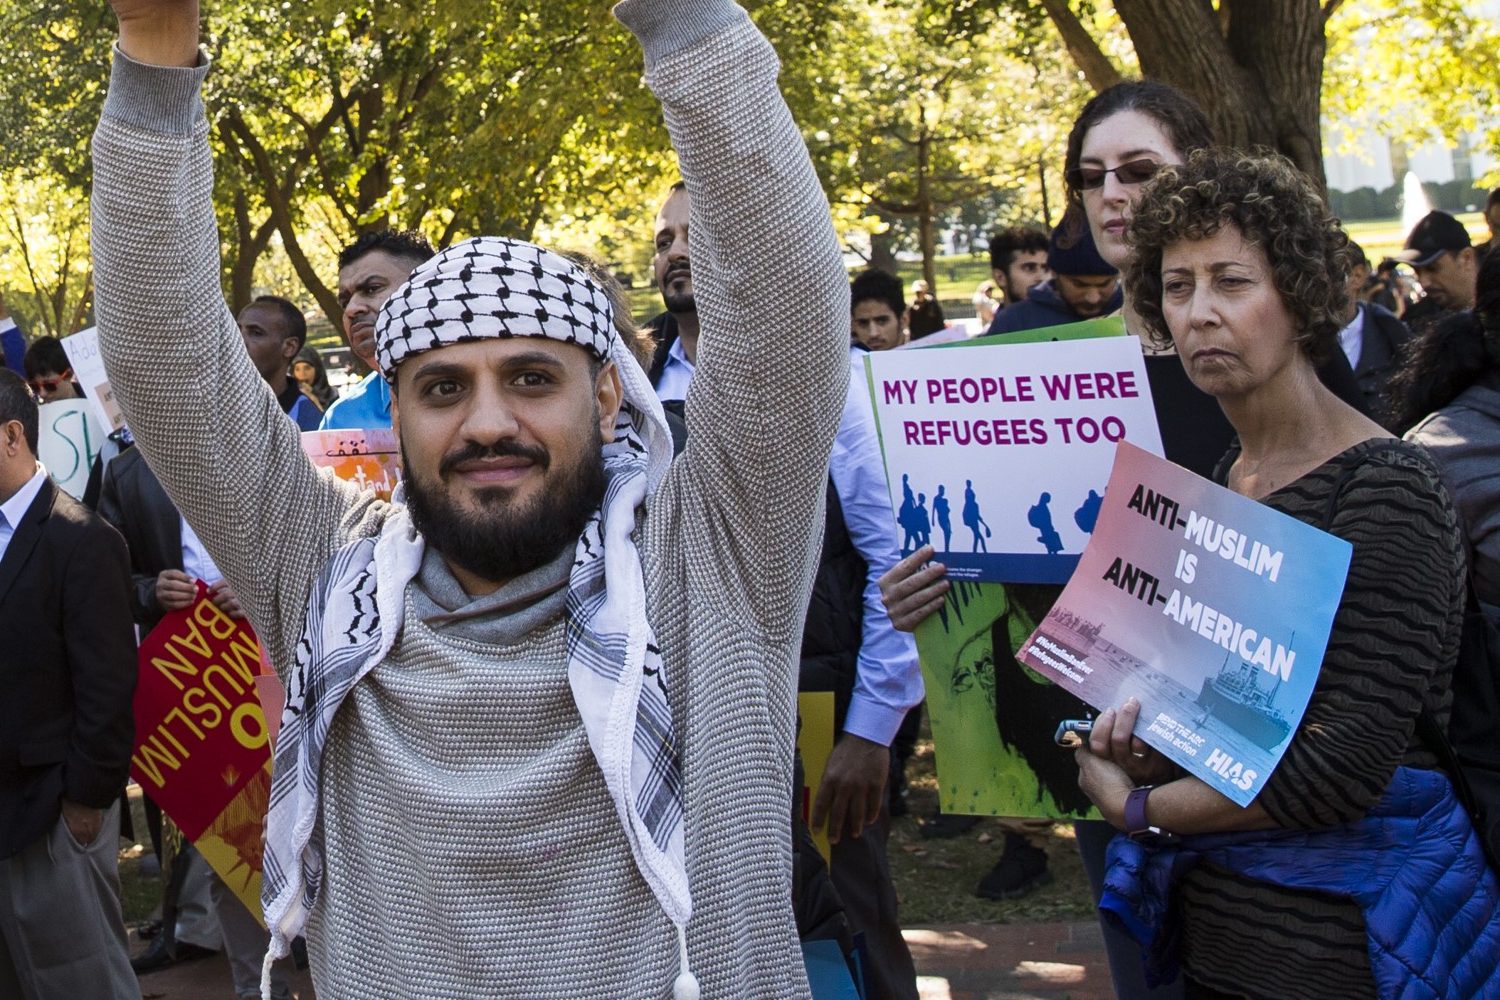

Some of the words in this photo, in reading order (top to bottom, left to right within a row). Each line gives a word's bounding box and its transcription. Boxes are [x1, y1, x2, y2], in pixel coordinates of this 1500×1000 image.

[883, 380, 918, 405] MY
[927, 376, 1035, 404] PEOPLE
[1040, 371, 1139, 401] WERE
[904, 418, 1048, 446] REFUGEES
[1054, 416, 1126, 444] TOO
[1127, 483, 1284, 583] ANTI-MUSLIM
[1174, 549, 1198, 584] IS
[1102, 556, 1296, 682] ANTI-AMERICAN
[151, 598, 237, 690] BAN
[1035, 636, 1094, 674] #NoMuslimBanEver
[1028, 645, 1084, 684] #RefugeesWelcome
[131, 631, 260, 789] MUSLIM
[1147, 721, 1175, 742] jewish
[1173, 737, 1197, 757] action
[1156, 712, 1178, 729] BEND
[1175, 723, 1191, 738] THE
[1187, 733, 1205, 747] ARC
[1204, 748, 1257, 791] HIAS
